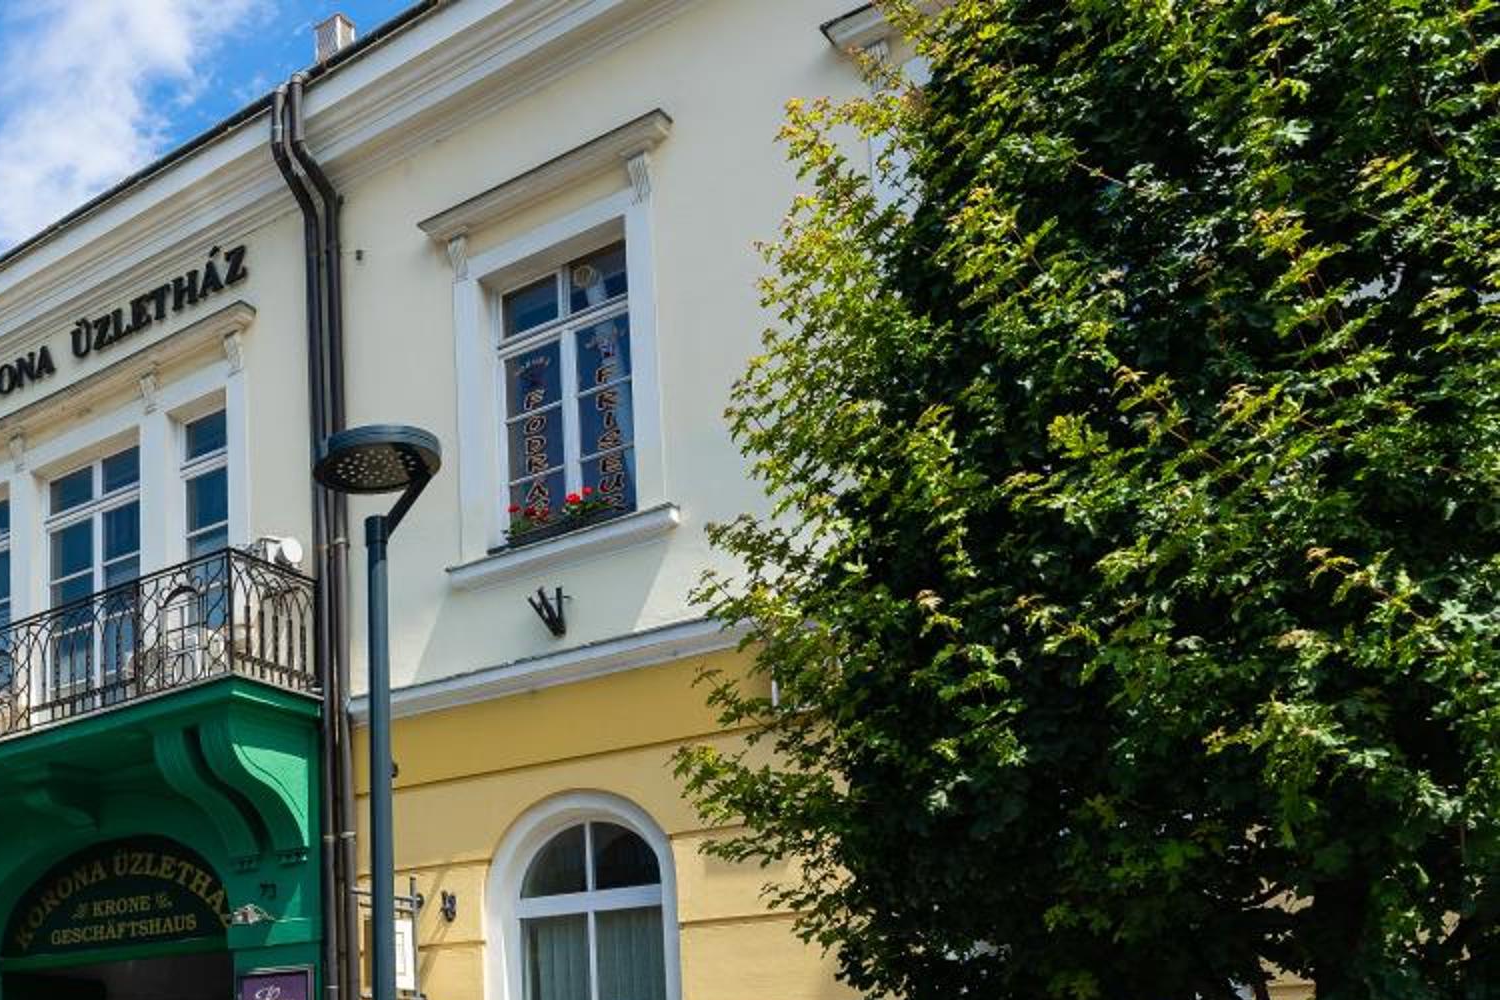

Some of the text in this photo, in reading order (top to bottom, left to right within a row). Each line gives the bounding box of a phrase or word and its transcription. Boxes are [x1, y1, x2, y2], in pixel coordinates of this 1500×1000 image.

[70, 245, 248, 360] ÜZLETHÁZ
[15, 859, 108, 949] KORONA
[51, 913, 197, 945] GESCHÄFTSHAUS
[92, 895, 151, 917] KRONE
